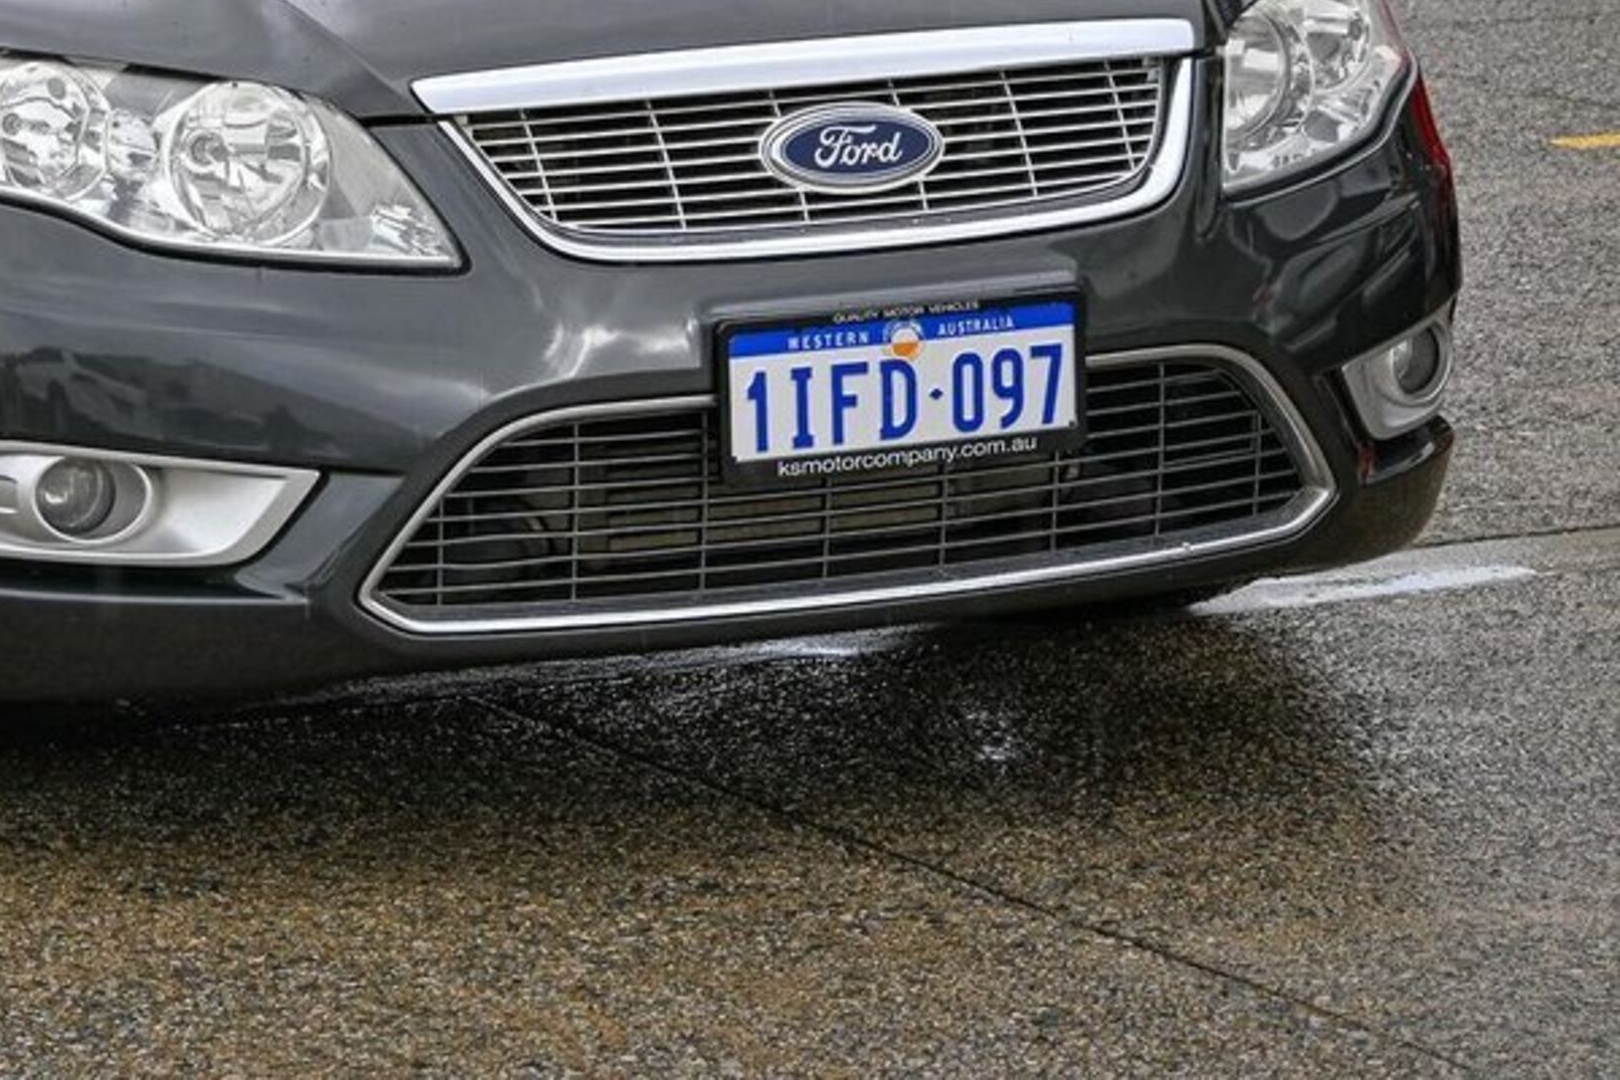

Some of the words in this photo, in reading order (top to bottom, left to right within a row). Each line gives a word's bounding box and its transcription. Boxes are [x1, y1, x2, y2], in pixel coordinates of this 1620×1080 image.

[813, 124, 903, 169] Ford
[787, 331, 870, 350] WESTERN
[937, 314, 1015, 336] AUSTRALIA
[776, 436, 1038, 477] ksmotorcompany.com.au
